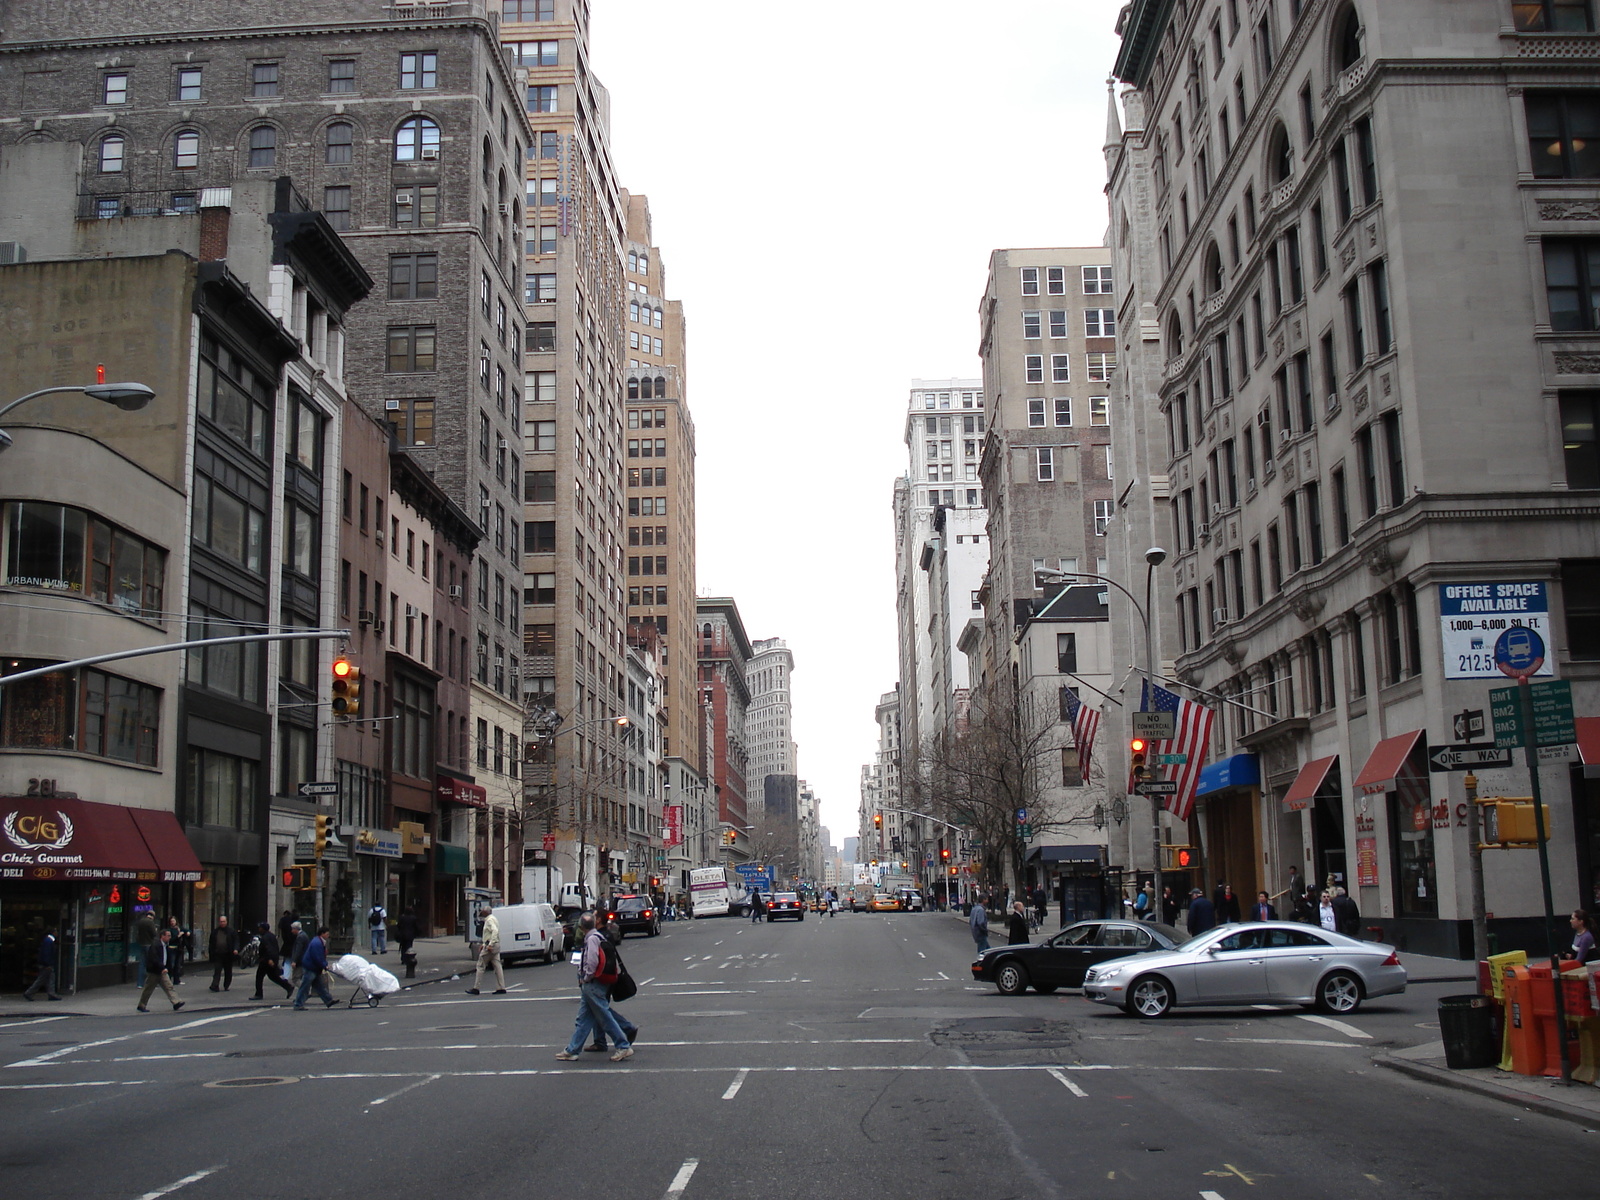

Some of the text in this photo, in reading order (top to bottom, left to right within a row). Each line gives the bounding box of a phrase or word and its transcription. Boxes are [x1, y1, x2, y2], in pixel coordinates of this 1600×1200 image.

[1445, 583, 1539, 599] OFFICE SPACE
[1460, 598, 1528, 612] AVAILABLE
[1528, 618, 1540, 628] FT.
[1491, 690, 1511, 702] BM1
[1493, 705, 1515, 717] BM2
[1471, 718, 1481, 730] WAY
[1494, 720, 1517, 732] BM3
[1496, 735, 1518, 748] BM4
[1169, 755, 1180, 763] 30
[1440, 750, 1501, 764] ONE WAY
[27, 778, 57, 797] 281
[37, 853, 83, 864] Gourmet
[3, 868, 24, 877] DELI
[37, 868, 53, 877] 281
